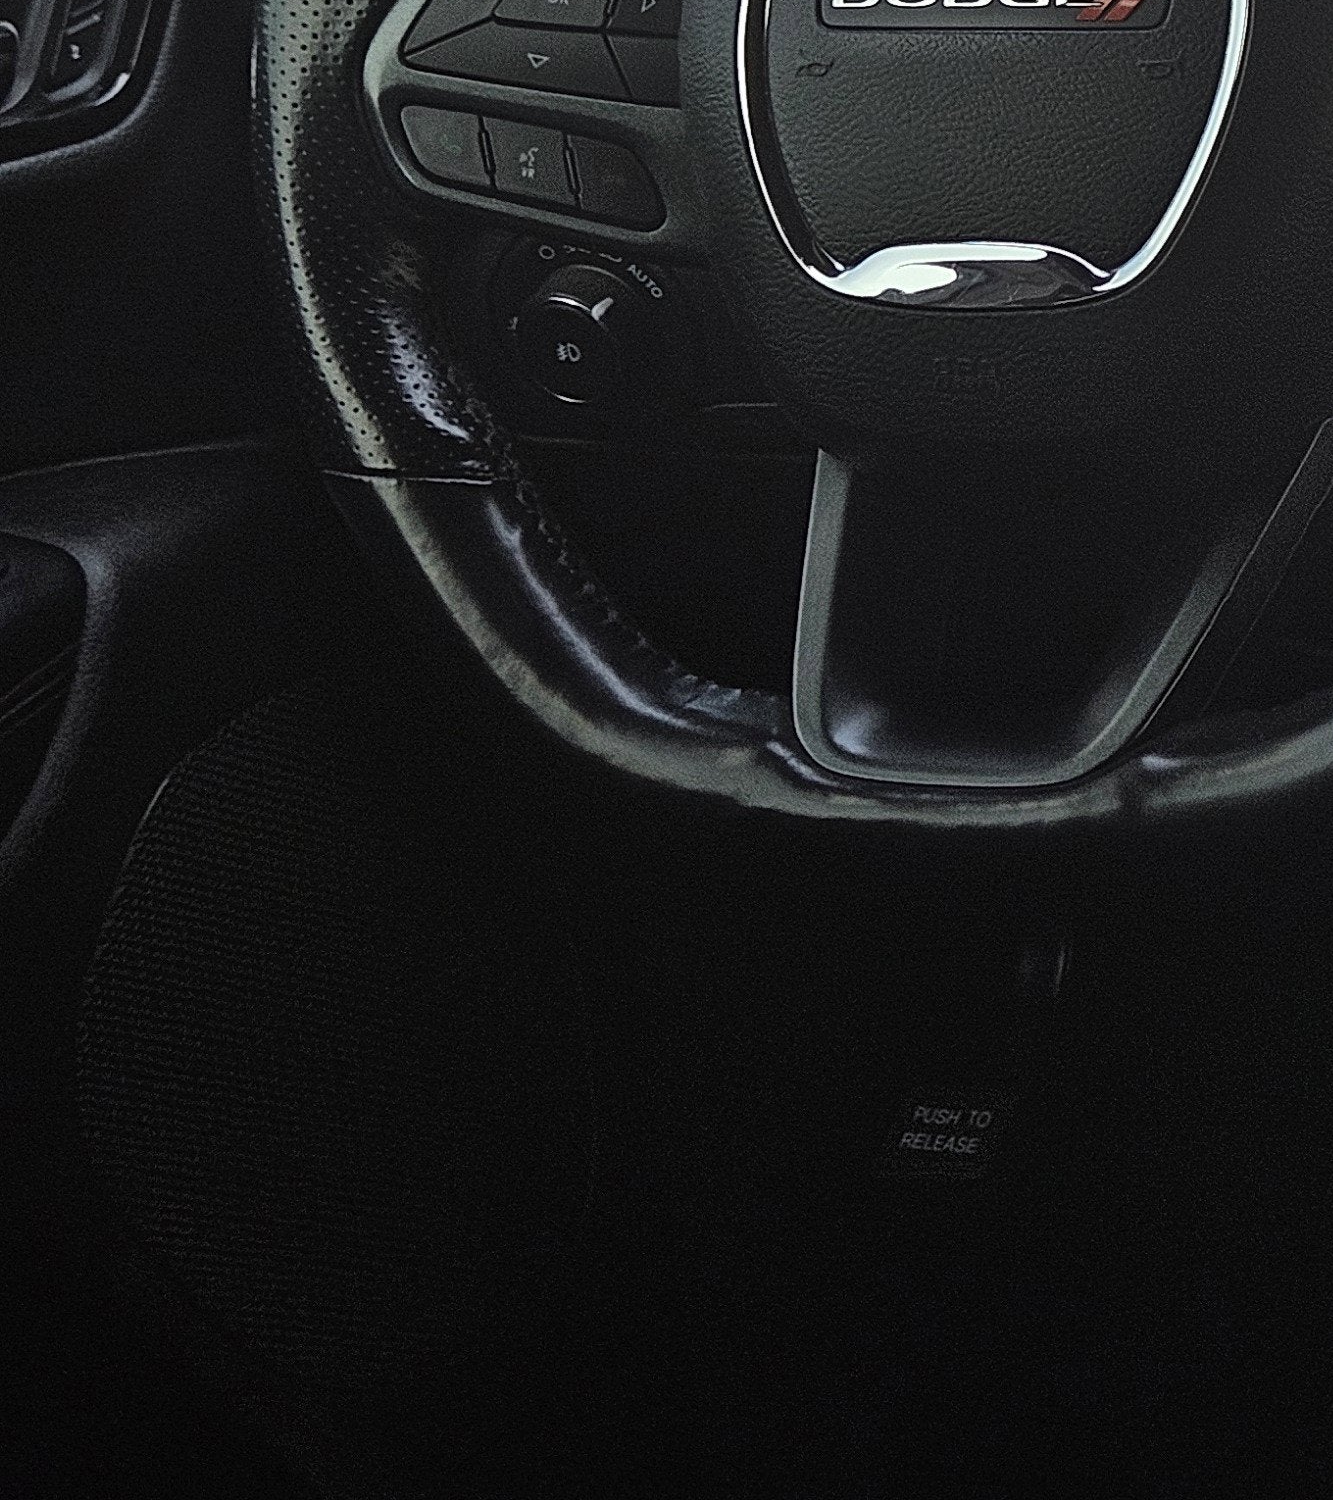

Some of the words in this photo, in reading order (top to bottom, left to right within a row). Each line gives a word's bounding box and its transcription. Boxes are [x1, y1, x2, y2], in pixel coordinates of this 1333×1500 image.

[627, 264, 663, 298] AUTO
[913, 1105, 962, 1125] PUSH
[970, 1110, 992, 1128] TO
[901, 1132, 980, 1153] RELEASE
